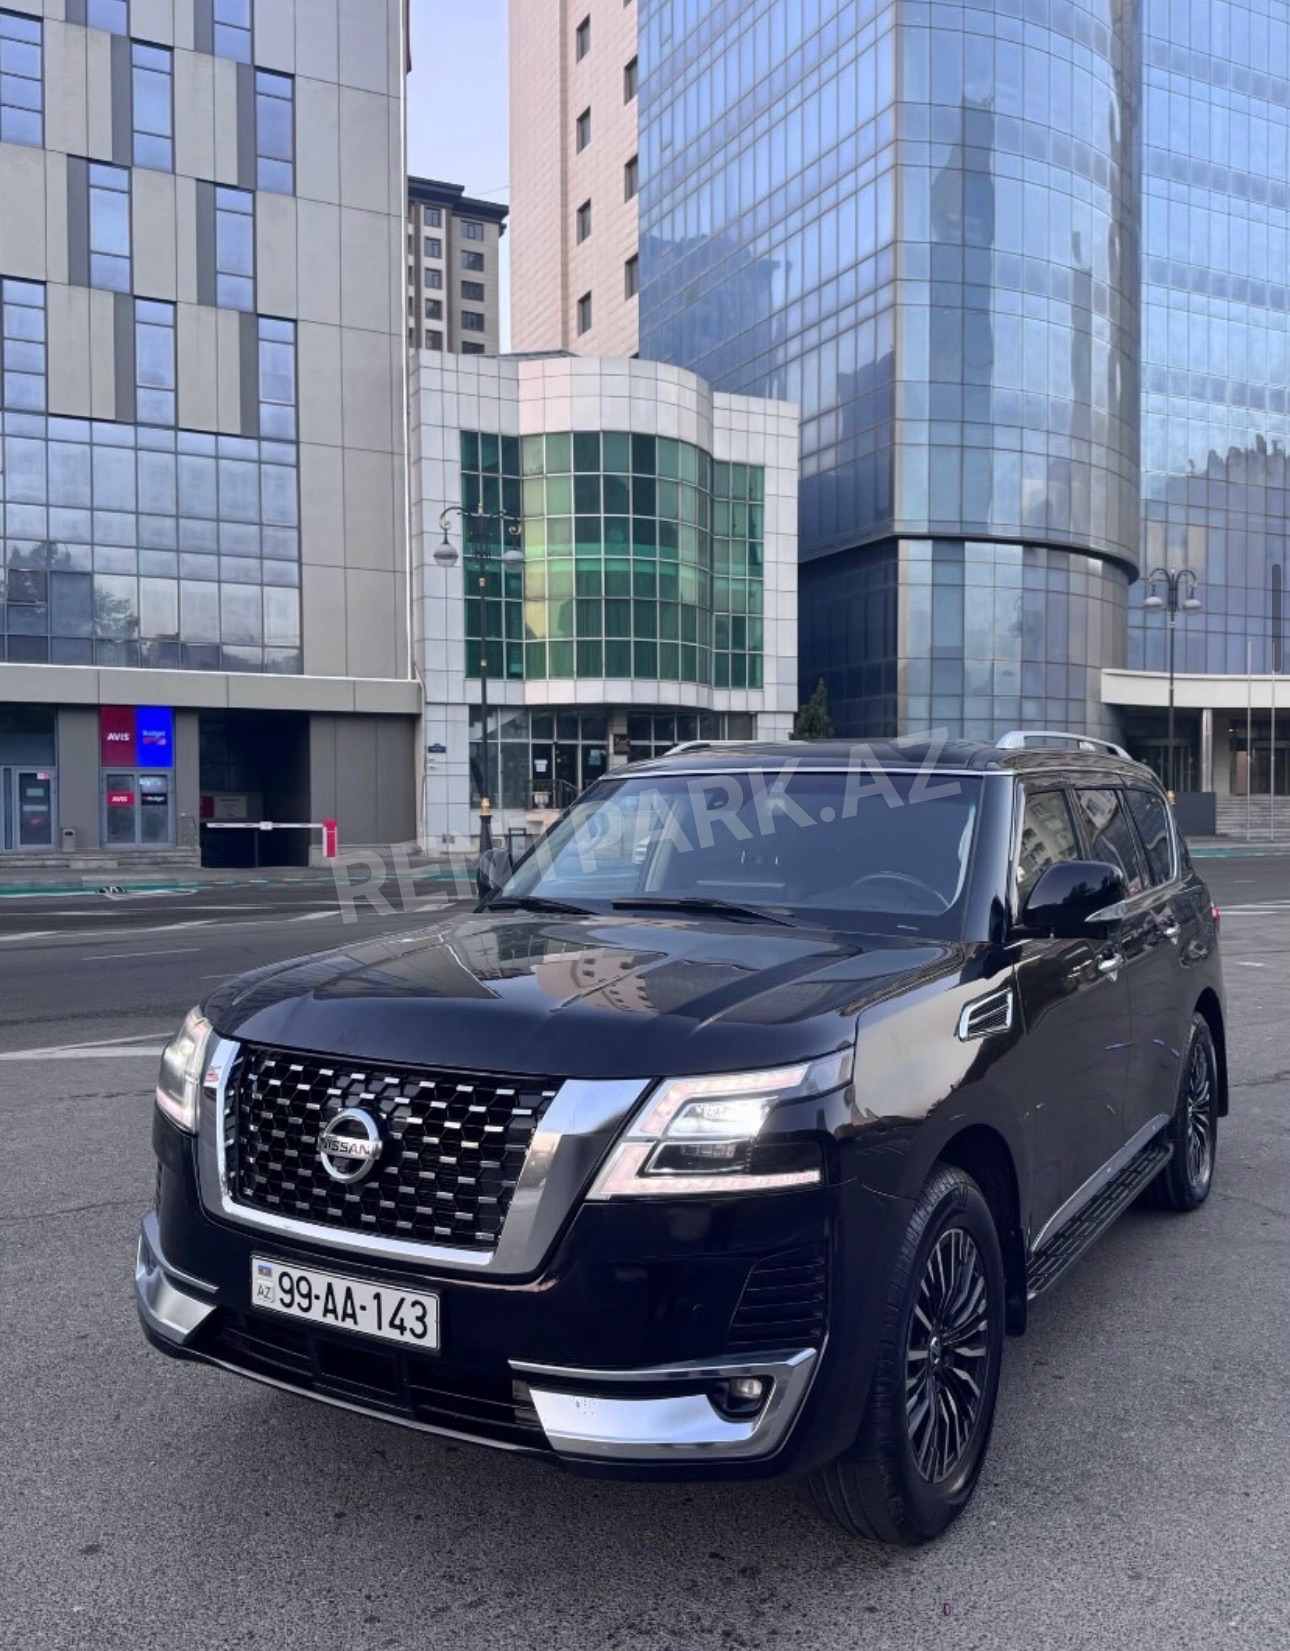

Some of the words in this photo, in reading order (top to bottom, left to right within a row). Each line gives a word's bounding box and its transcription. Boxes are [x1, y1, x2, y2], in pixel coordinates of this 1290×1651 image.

[107, 732, 130, 741] AVIS
[318, 1138, 370, 1155] NISSAN
[257, 1284, 272, 1301] AZ
[278, 1271, 428, 1340] 99-AA-143
